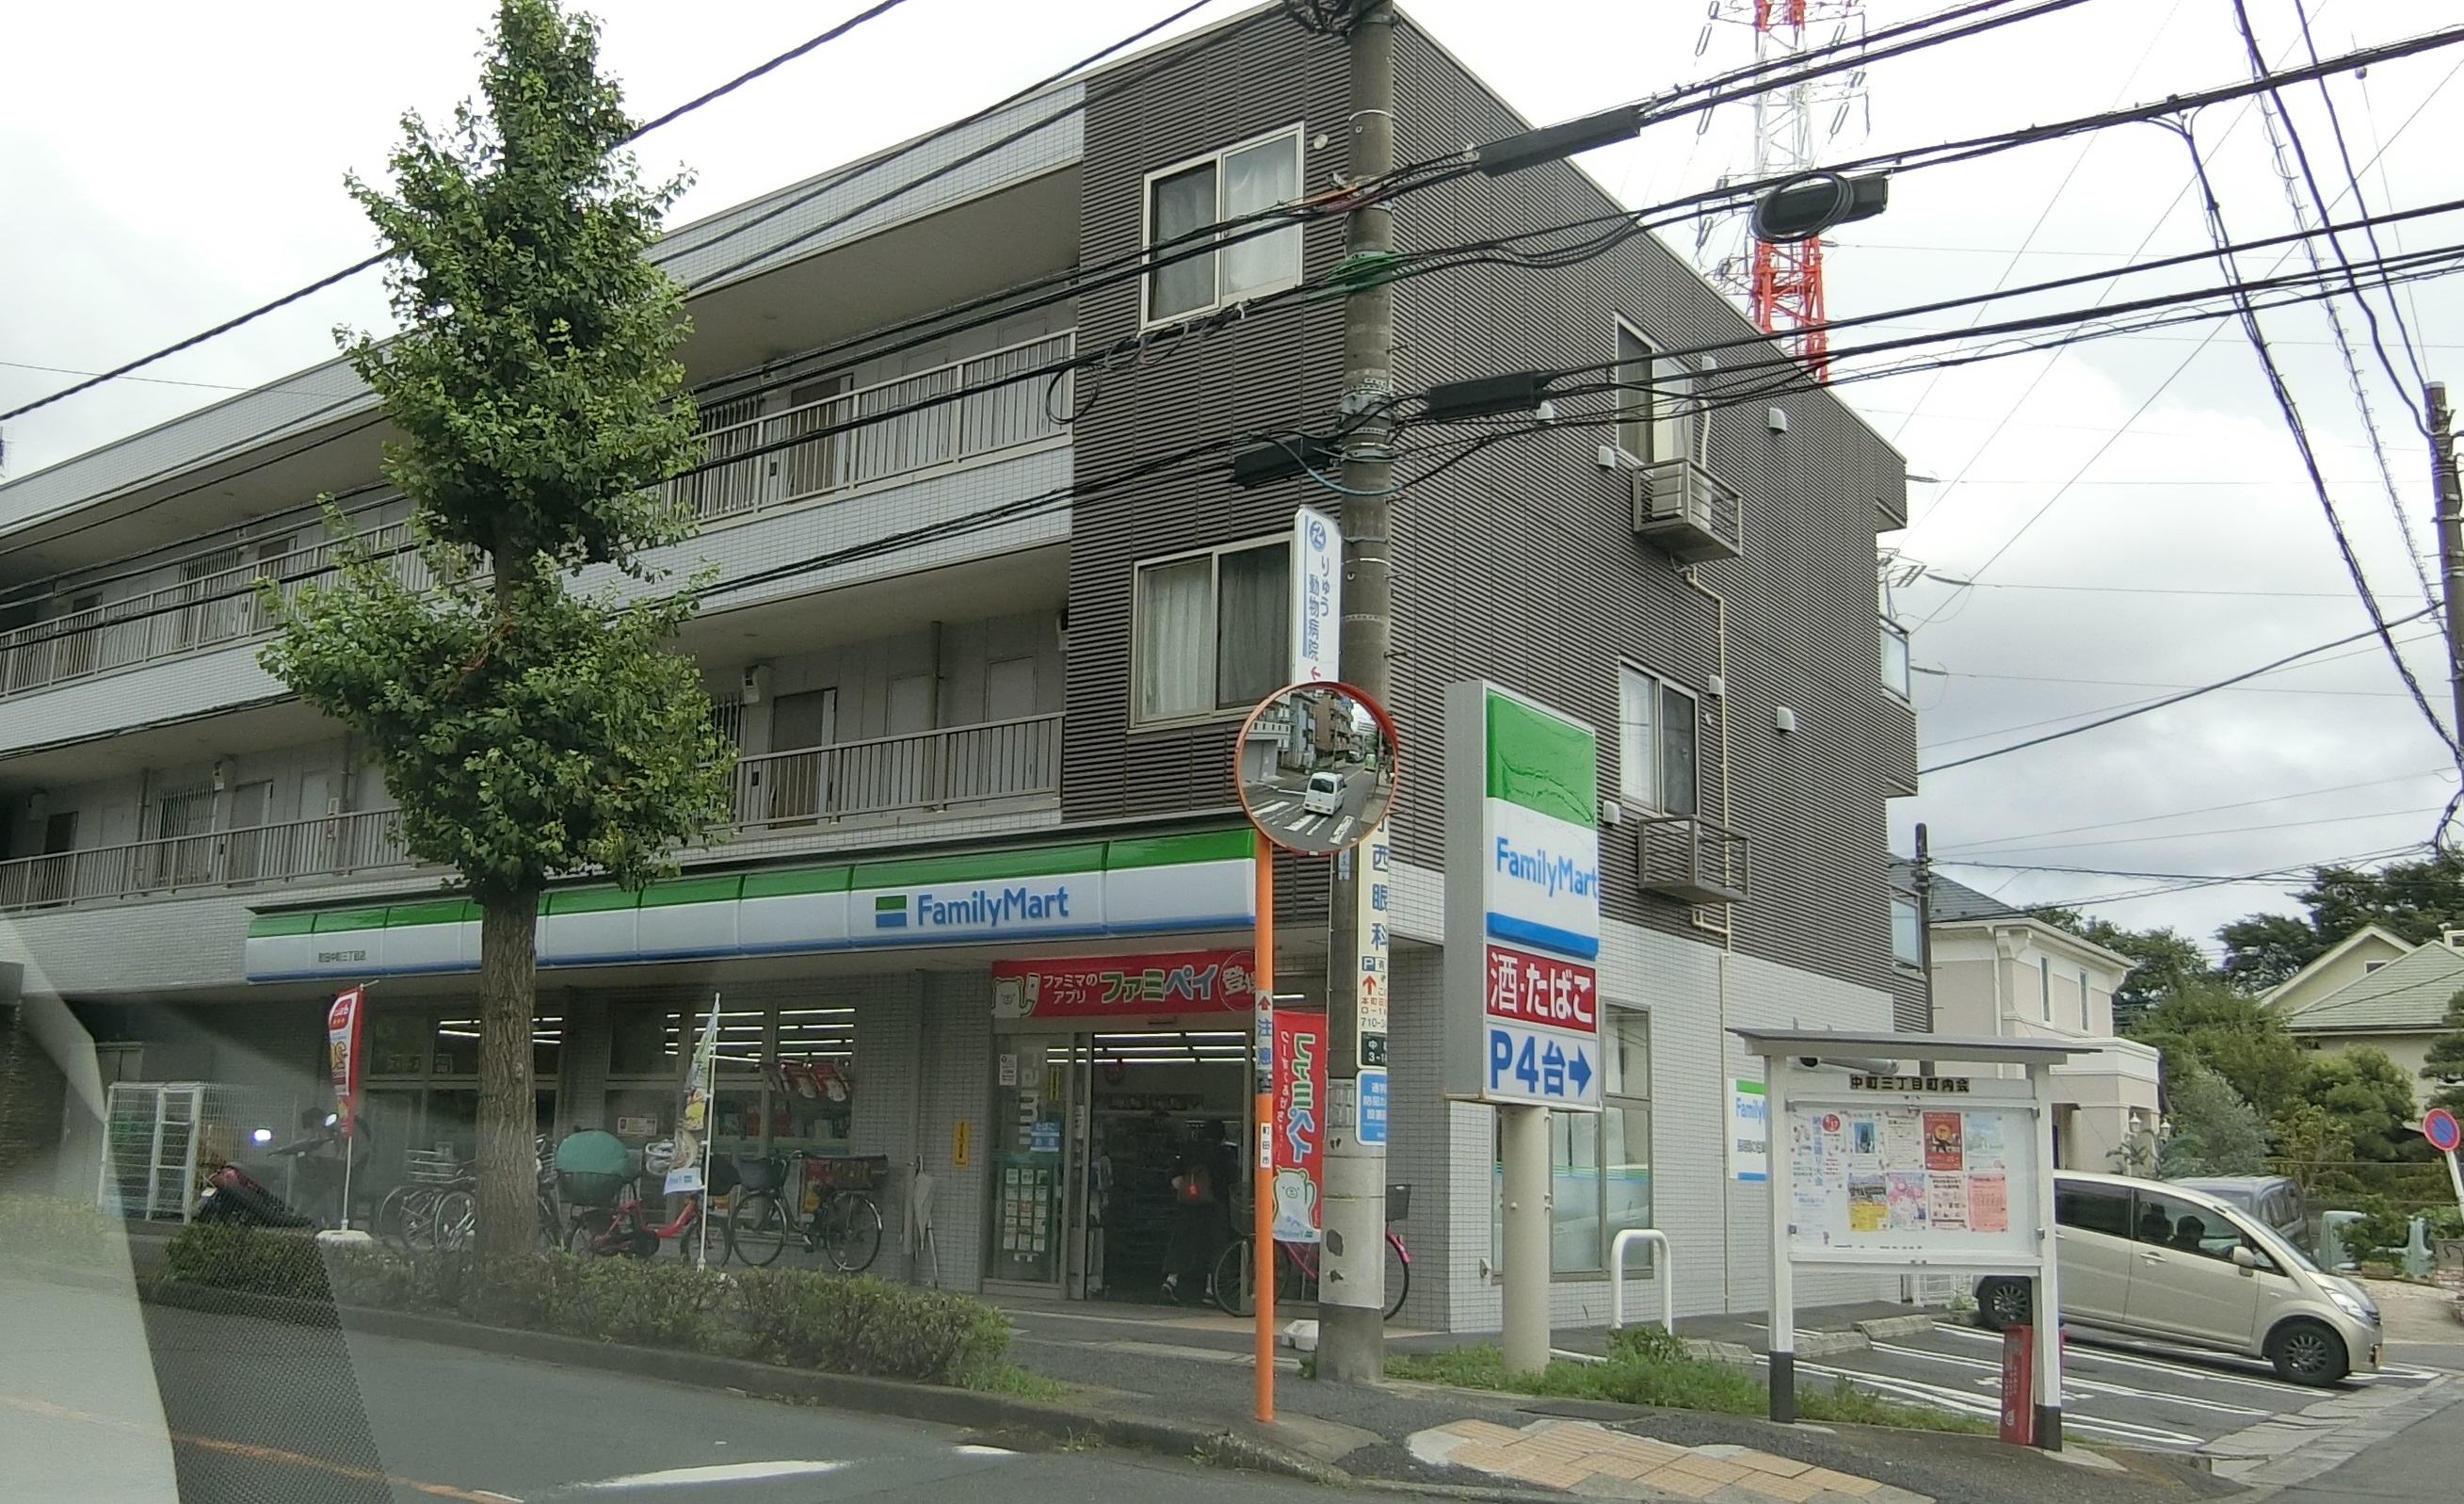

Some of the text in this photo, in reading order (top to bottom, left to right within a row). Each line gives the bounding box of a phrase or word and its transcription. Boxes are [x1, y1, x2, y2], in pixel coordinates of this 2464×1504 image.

[1496, 836, 1598, 898] FamilyMart
[918, 885, 1070, 927] FamilyMart
[1043, 974, 1098, 989] ファミマの
[1053, 990, 1087, 1005] アプリ
[1100, 963, 1219, 1004] ファミペイ
[1258, 1018, 1272, 1065] 注意
[1851, 1075, 1970, 1092] 中町三丁目町内会
[1736, 1097, 1765, 1124] Family
[1262, 1125, 1270, 1165] 町田市
